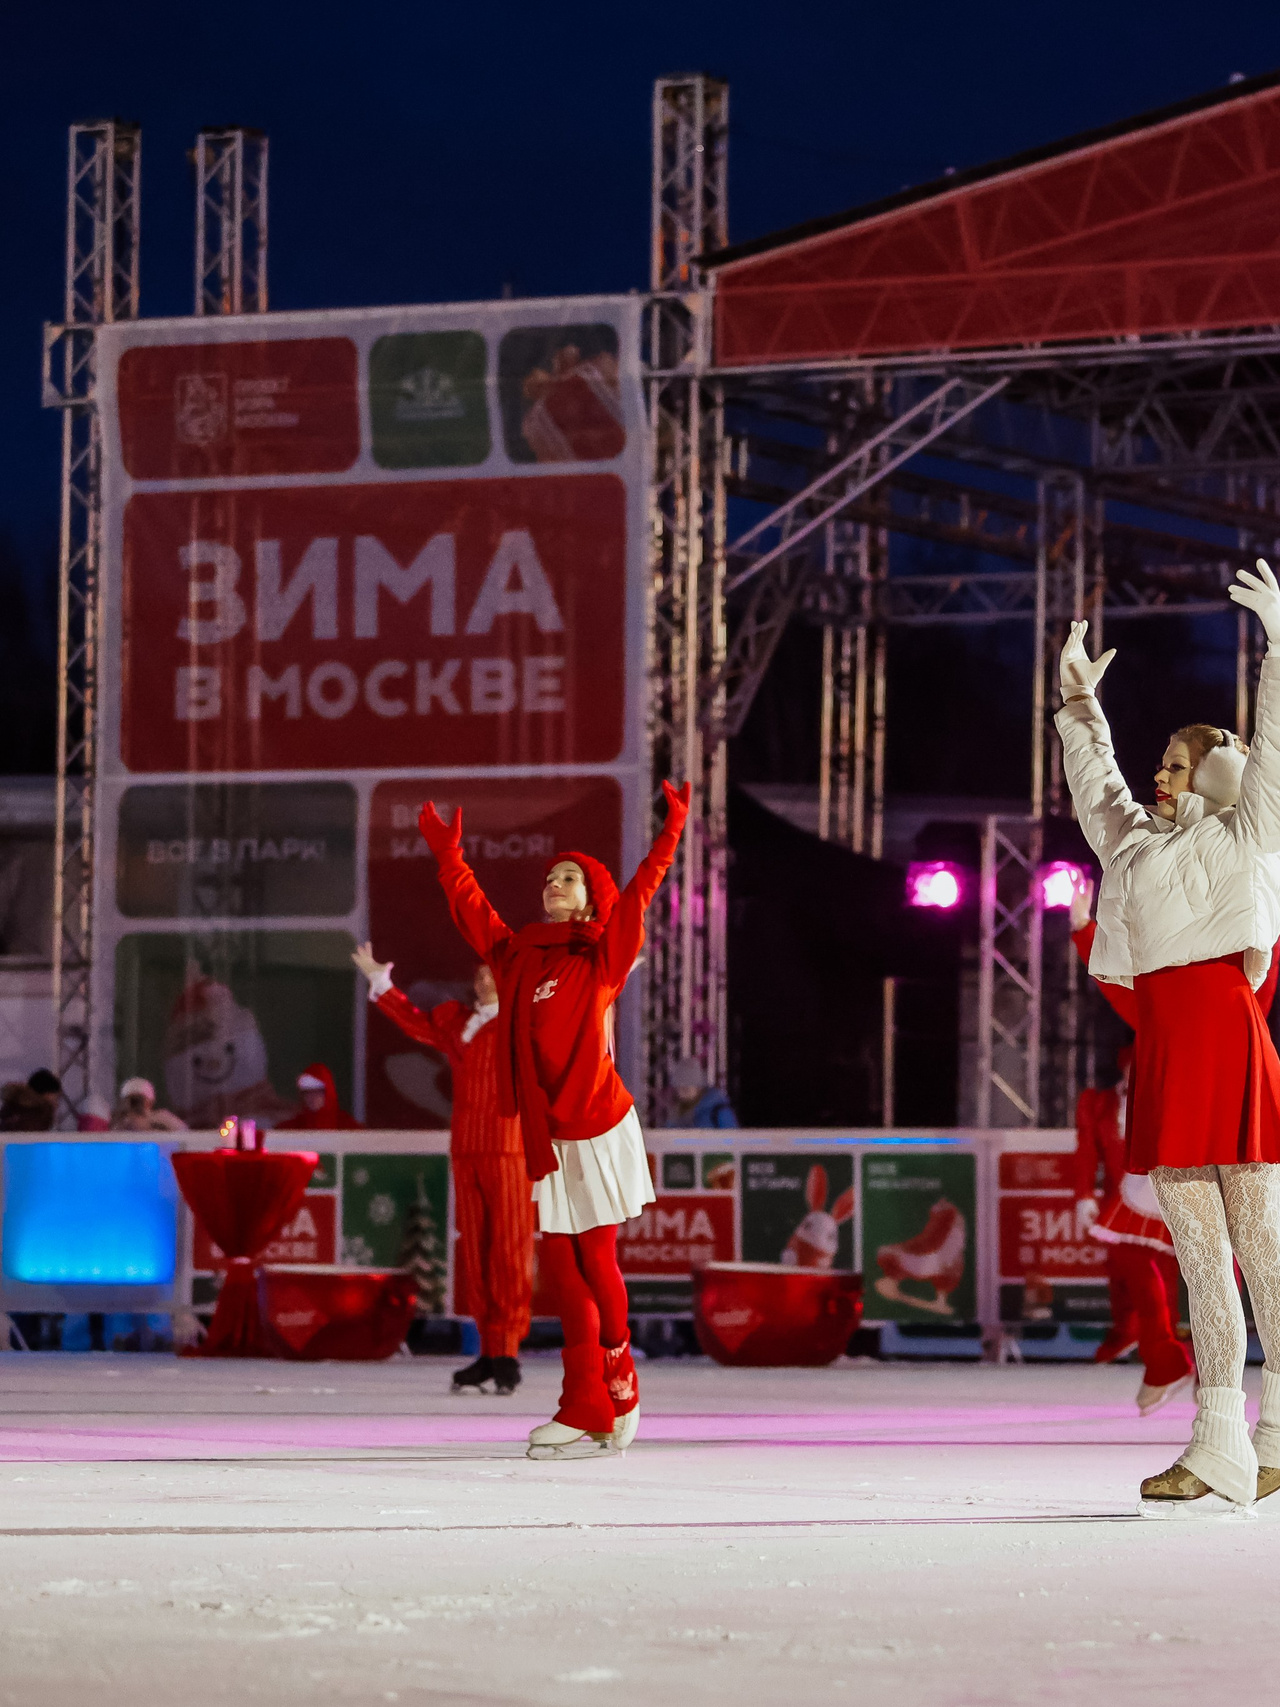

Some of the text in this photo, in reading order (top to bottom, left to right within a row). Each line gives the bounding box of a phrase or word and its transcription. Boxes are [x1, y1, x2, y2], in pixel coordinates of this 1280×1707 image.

[176, 528, 563, 645] ЗИМА
[174, 655, 566, 721] В МОСКВЕ
[618, 1209, 715, 1240] ИМА
